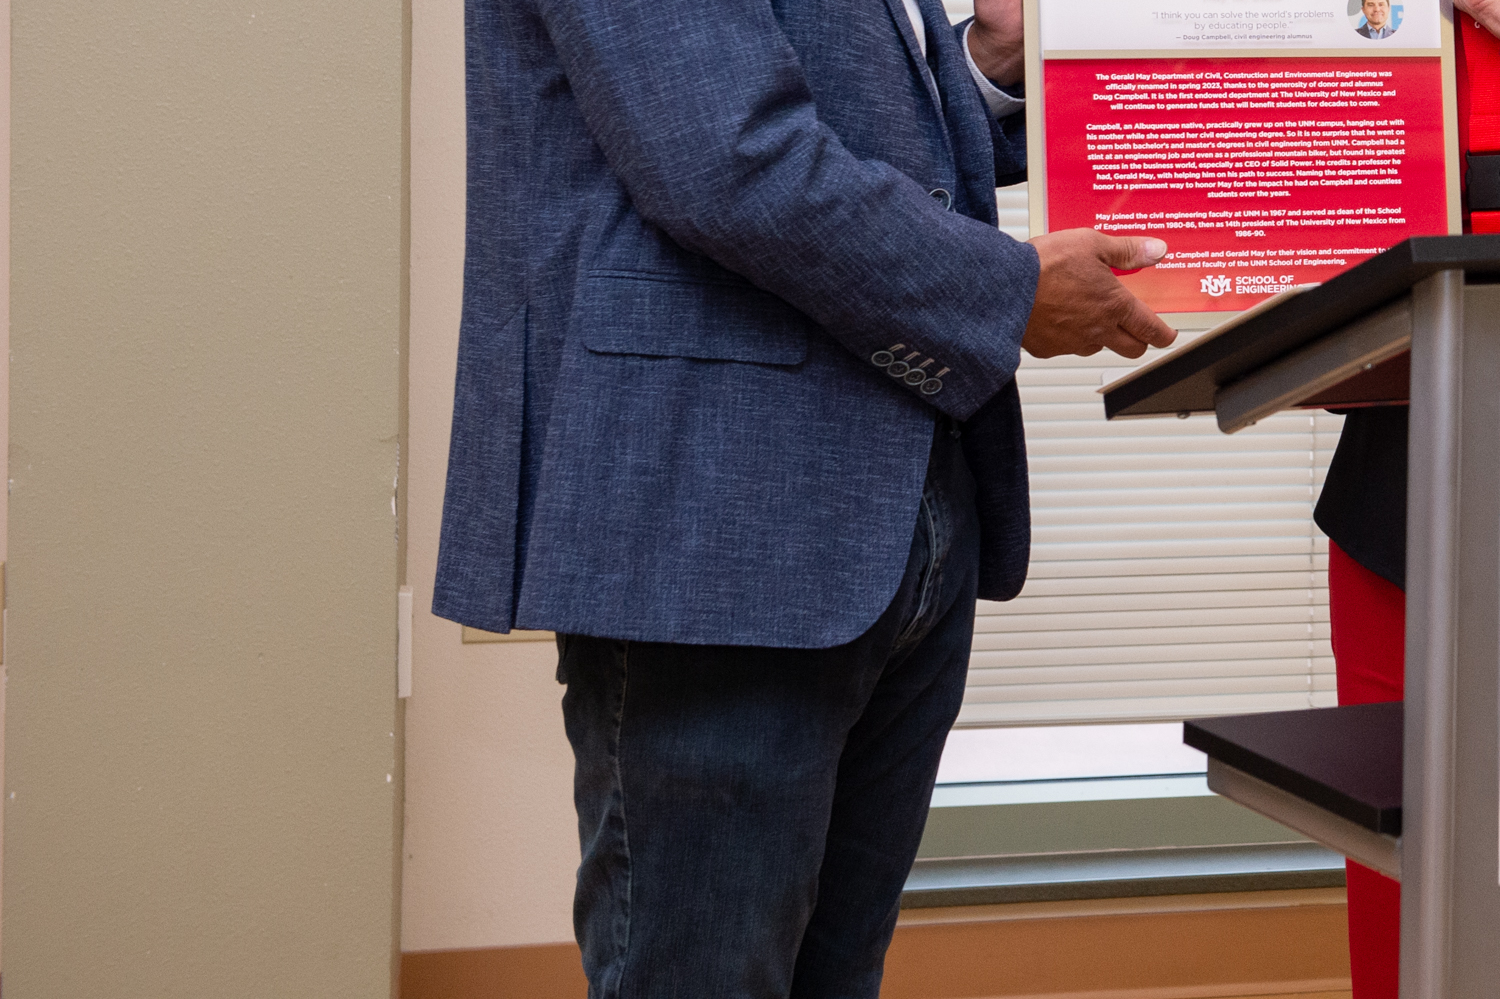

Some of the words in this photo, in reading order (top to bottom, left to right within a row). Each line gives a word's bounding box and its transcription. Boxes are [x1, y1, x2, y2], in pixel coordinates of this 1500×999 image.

[1294, 10, 1335, 19] problems
[1194, 22, 1206, 31] by
[1208, 22, 1254, 31] educating
[1105, 83, 1137, 91] officially
[1165, 211, 1208, 220] engineering
[1303, 258, 1347, 266] Engineering.
[1236, 275, 1277, 285] SCHOOL
[1279, 275, 1294, 284] OF
